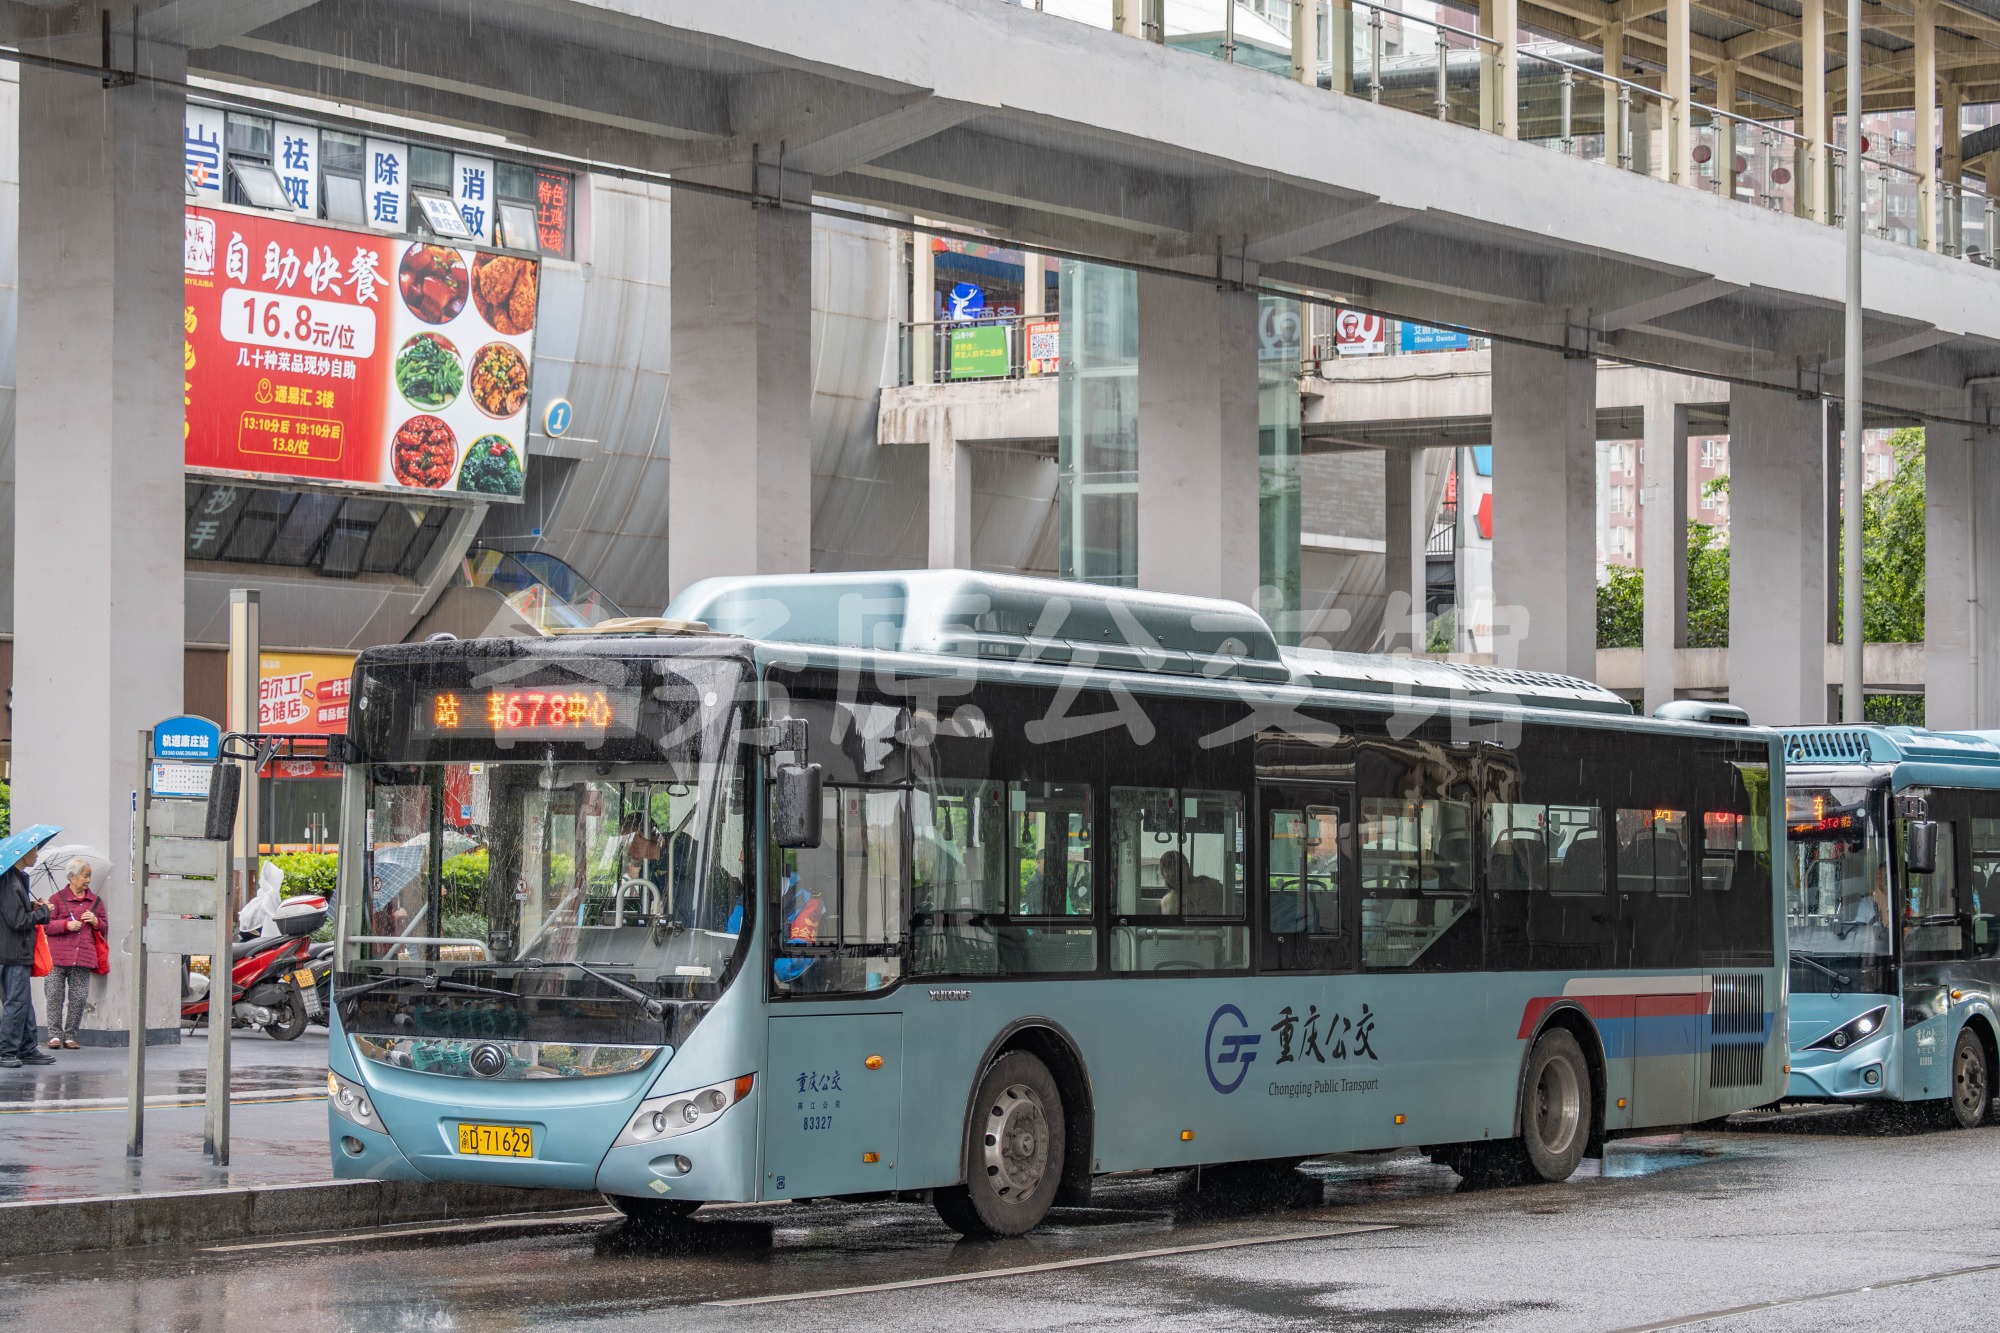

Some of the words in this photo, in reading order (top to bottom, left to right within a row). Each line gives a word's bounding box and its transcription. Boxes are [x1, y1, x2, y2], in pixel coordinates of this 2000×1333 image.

[225, 230, 390, 305] 自助快餐
[243, 297, 355, 350] 16.8元/位
[236, 347, 356, 380] 几十种菜品现炒自助
[274, 385, 312, 406] 通易汇
[315, 390, 335, 409] 3楼
[243, 417, 291, 435] 13:10分后
[295, 422, 341, 440] 19:10分后
[553, 408, 565, 430] 1
[271, 437, 310, 455] 13.8/位
[162, 734, 209, 748] 轨道康庄站
[928, 989, 972, 1002] YUTONG
[1270, 1003, 1378, 1065] 重庆公交
[796, 1070, 842, 1094] 重庆公交
[1268, 1081, 1313, 1098] Chongqing
[1314, 1079, 1339, 1094] Public
[1341, 1077, 1379, 1094] Transport
[803, 1116, 833, 1130] 83327
